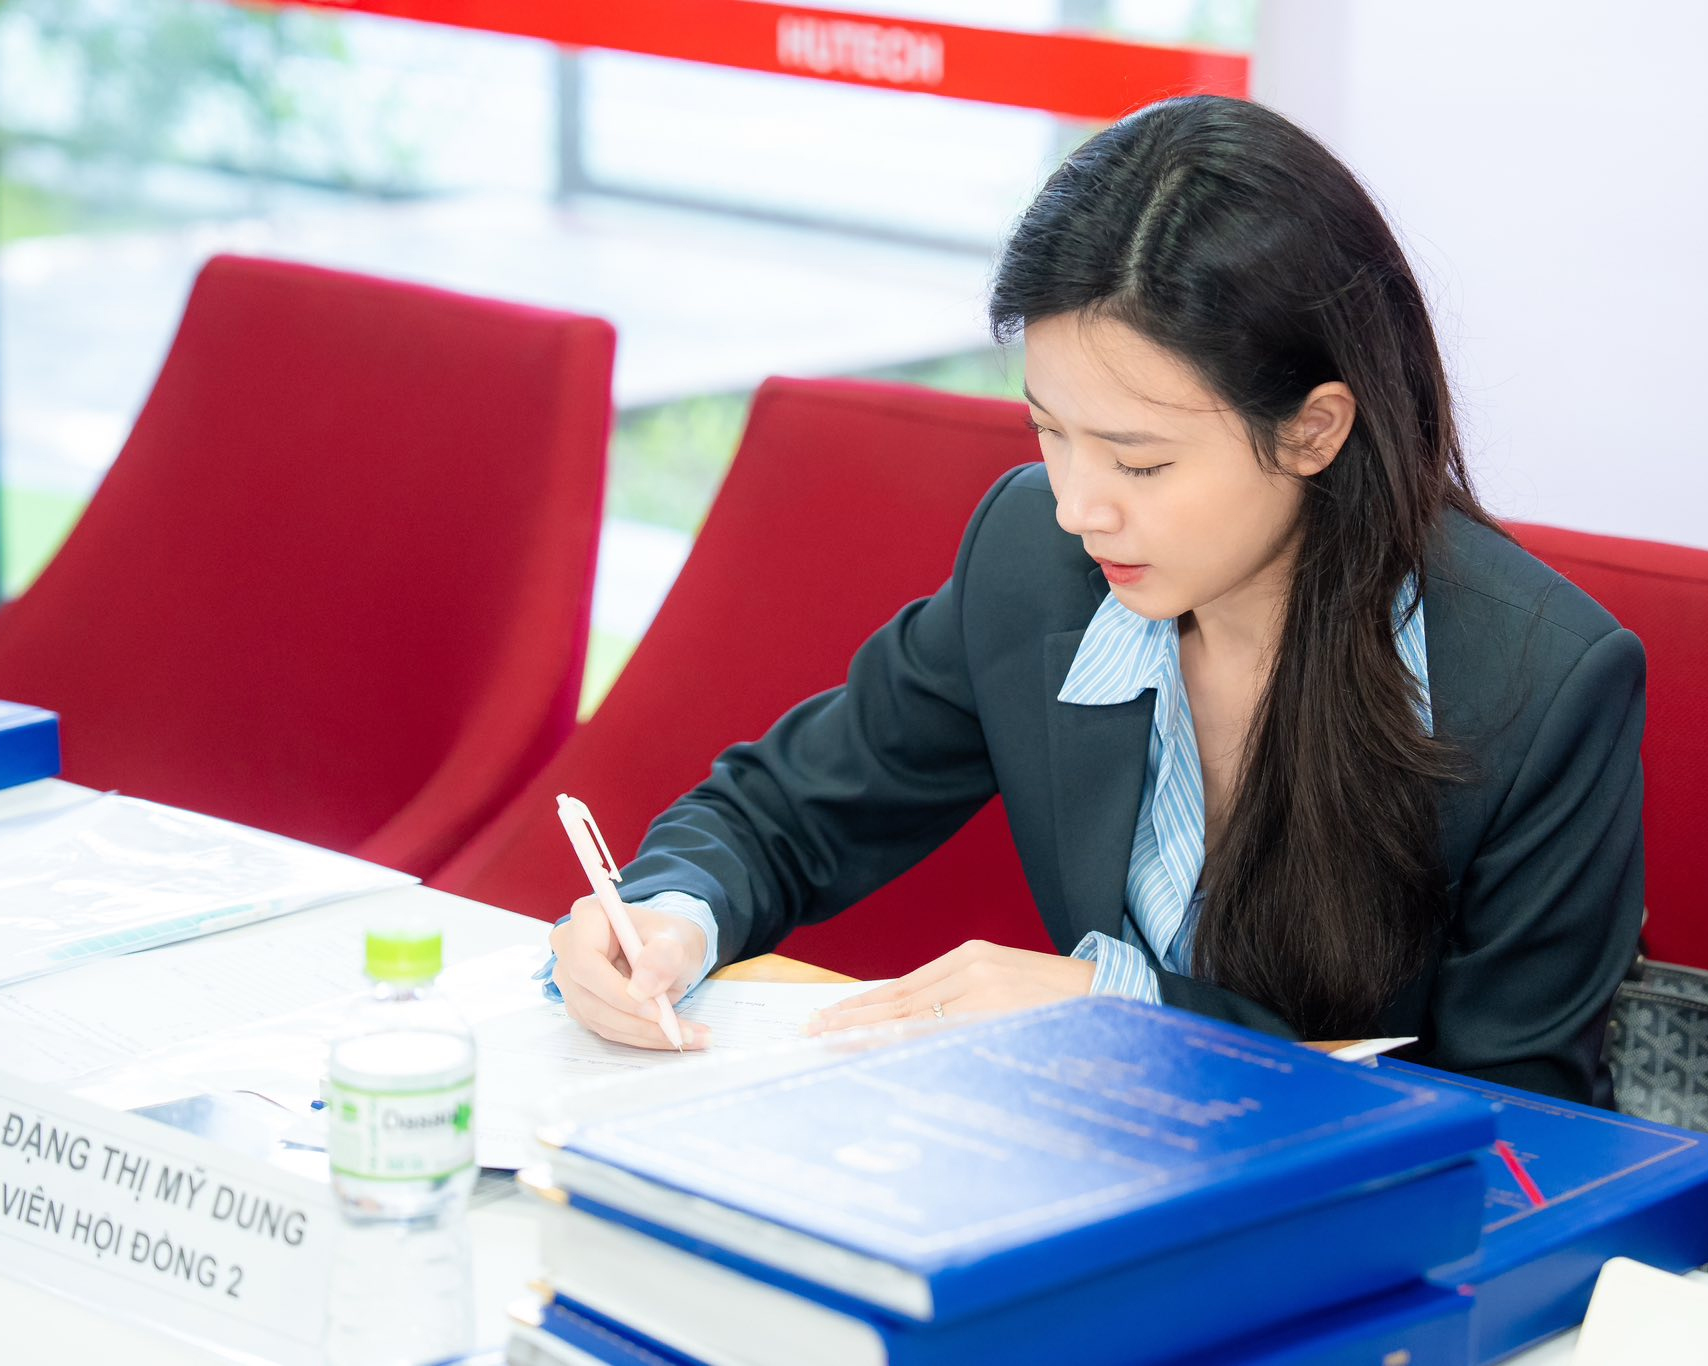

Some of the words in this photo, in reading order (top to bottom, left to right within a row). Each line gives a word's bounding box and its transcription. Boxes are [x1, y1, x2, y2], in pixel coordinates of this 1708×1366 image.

[777, 14, 944, 86] HUTECH
[3, 1182, 64, 1235] VIÊN
[226, 1264, 244, 1298] 2
[102, 1145, 150, 1202] THỊ
[155, 1166, 206, 1209] MỸ
[212, 1184, 307, 1246] DUNG
